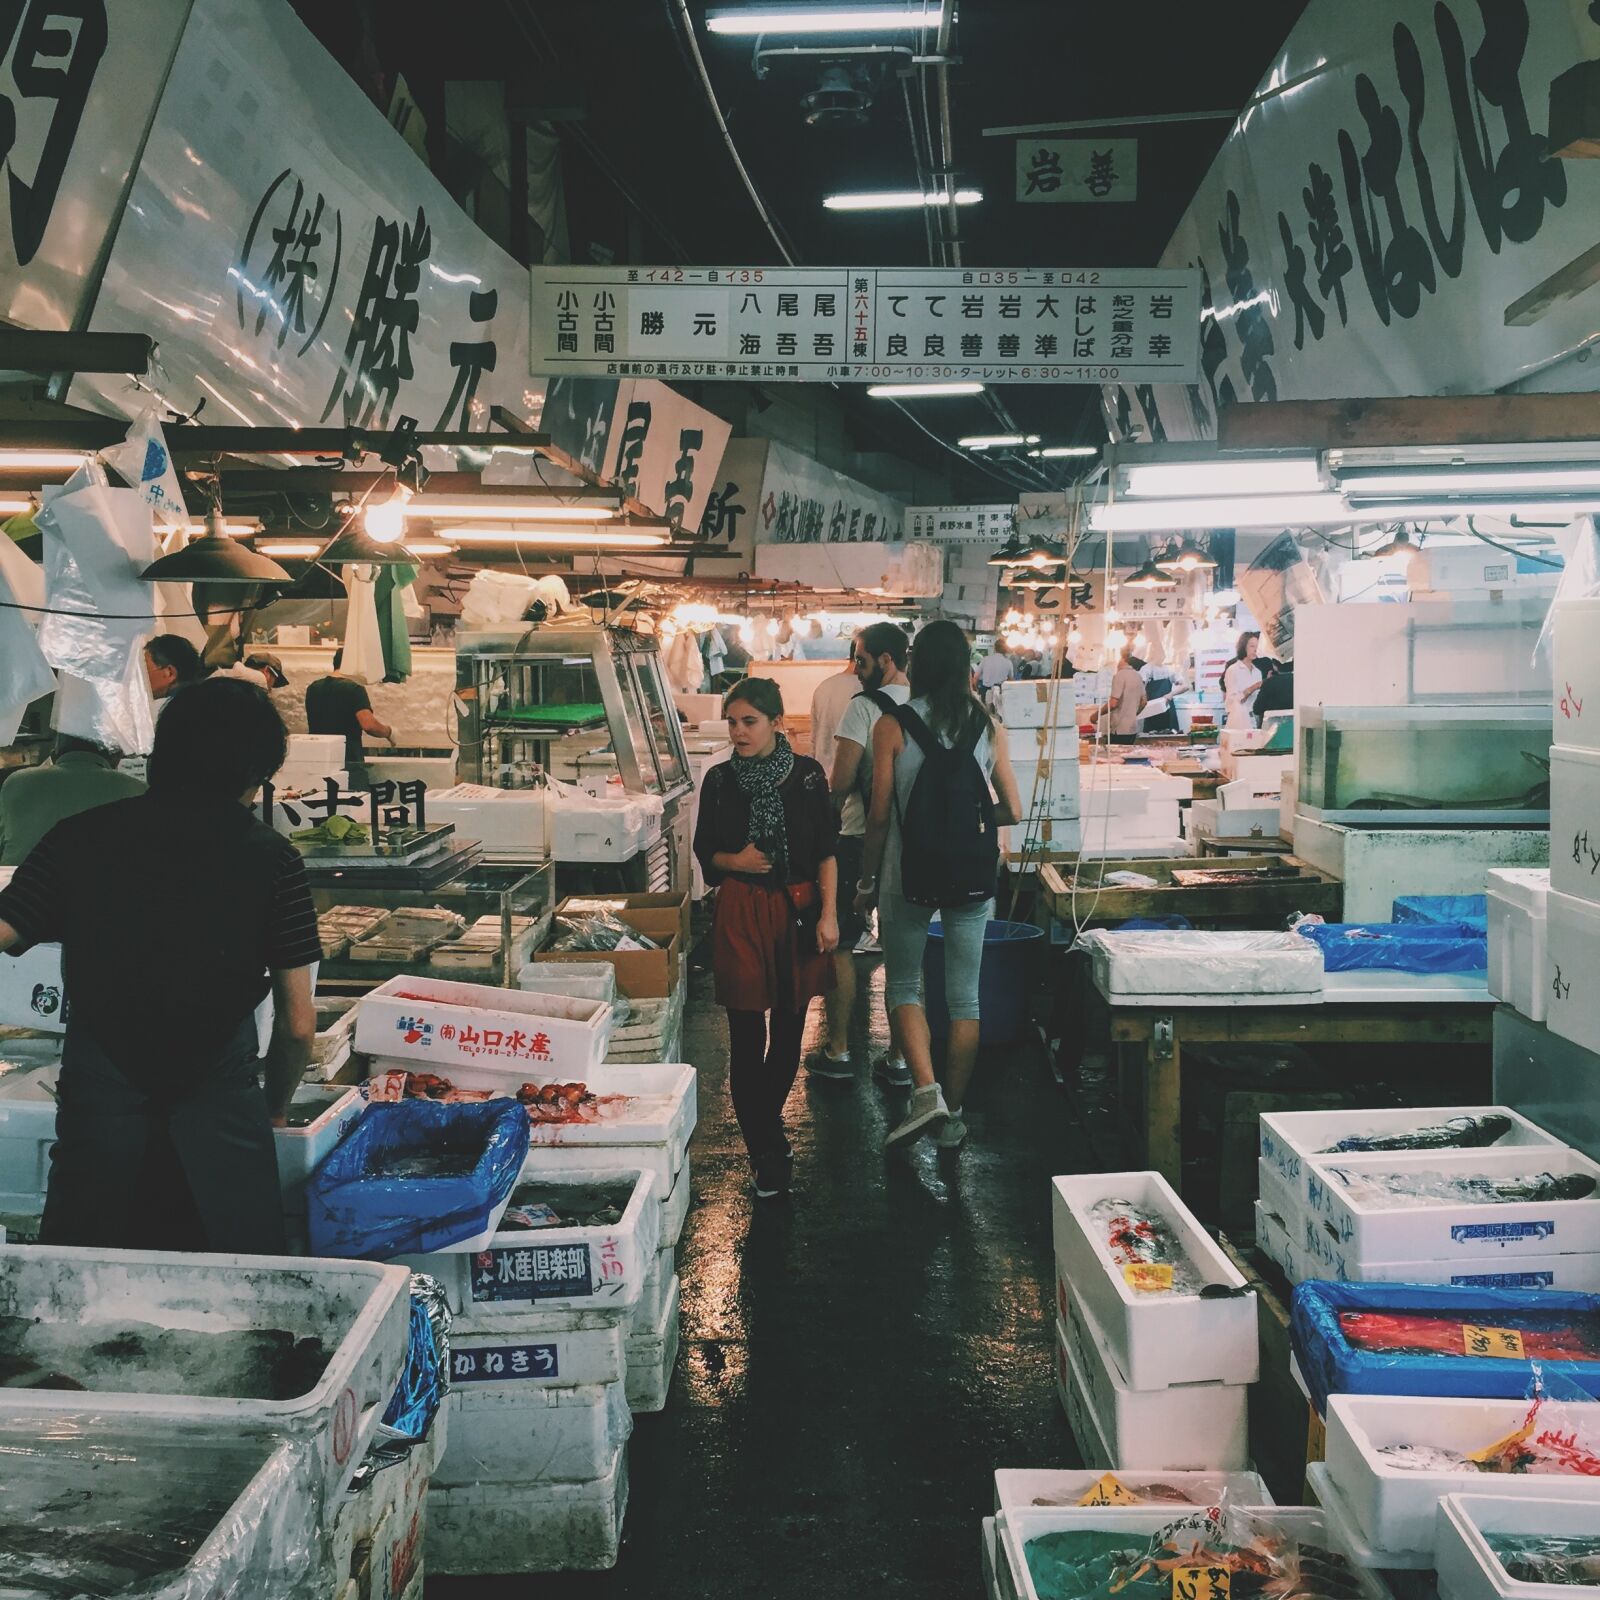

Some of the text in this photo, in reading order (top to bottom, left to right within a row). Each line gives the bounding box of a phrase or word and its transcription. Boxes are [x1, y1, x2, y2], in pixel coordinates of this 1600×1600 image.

[557, 291, 579, 353] 小古間
[593, 291, 616, 354] 小古間
[640, 312, 717, 337] 勝元
[739, 292, 762, 356] 八海
[852, 277, 869, 358] 第六十五棟
[886, 295, 910, 357] て良
[923, 295, 946, 357] て良
[960, 294, 985, 358] 岩善
[997, 294, 1022, 358] 岩善
[1072, 295, 1097, 358] はしば
[1148, 294, 1173, 359] 岩幸
[454, 1349, 555, 1376] かねきう
